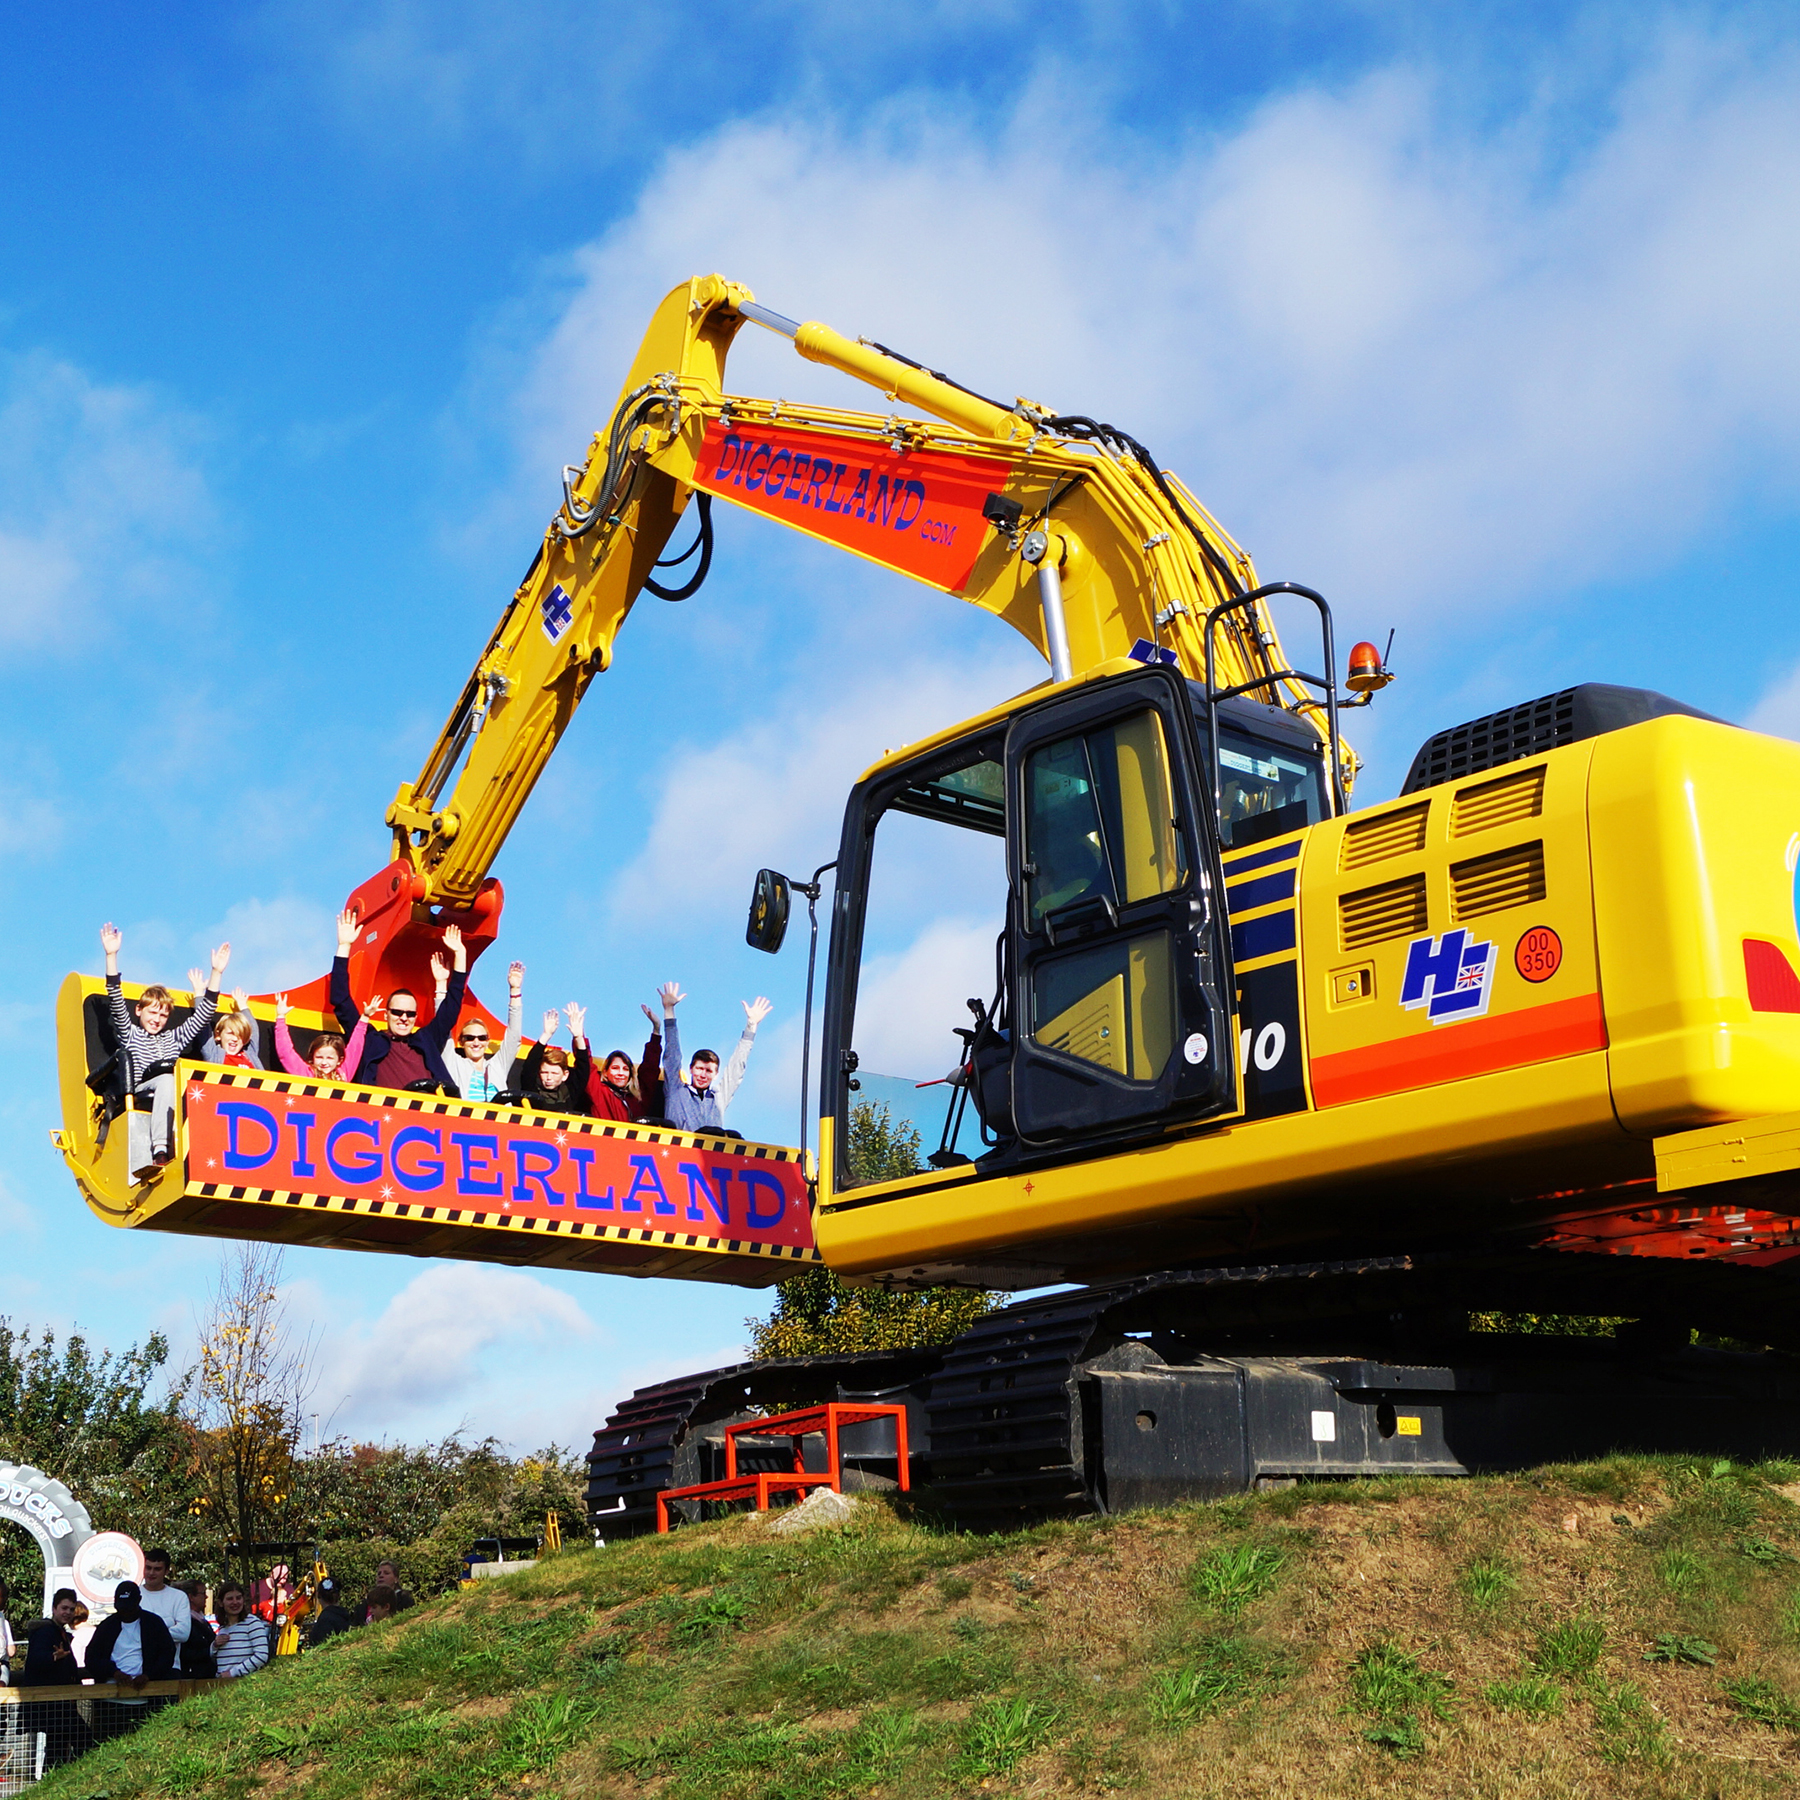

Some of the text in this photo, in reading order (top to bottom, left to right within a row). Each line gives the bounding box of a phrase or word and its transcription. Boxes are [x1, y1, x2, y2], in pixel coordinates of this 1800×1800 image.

[714, 434, 926, 531] DIGGERLAND
[1528, 933, 1548, 952] 00
[1523, 951, 1555, 973] 350
[216, 1101, 786, 1229] DIGGERLAND
[12, 1508, 48, 1541] quackers!
[89, 1541, 135, 1563] DIGGERLAND
